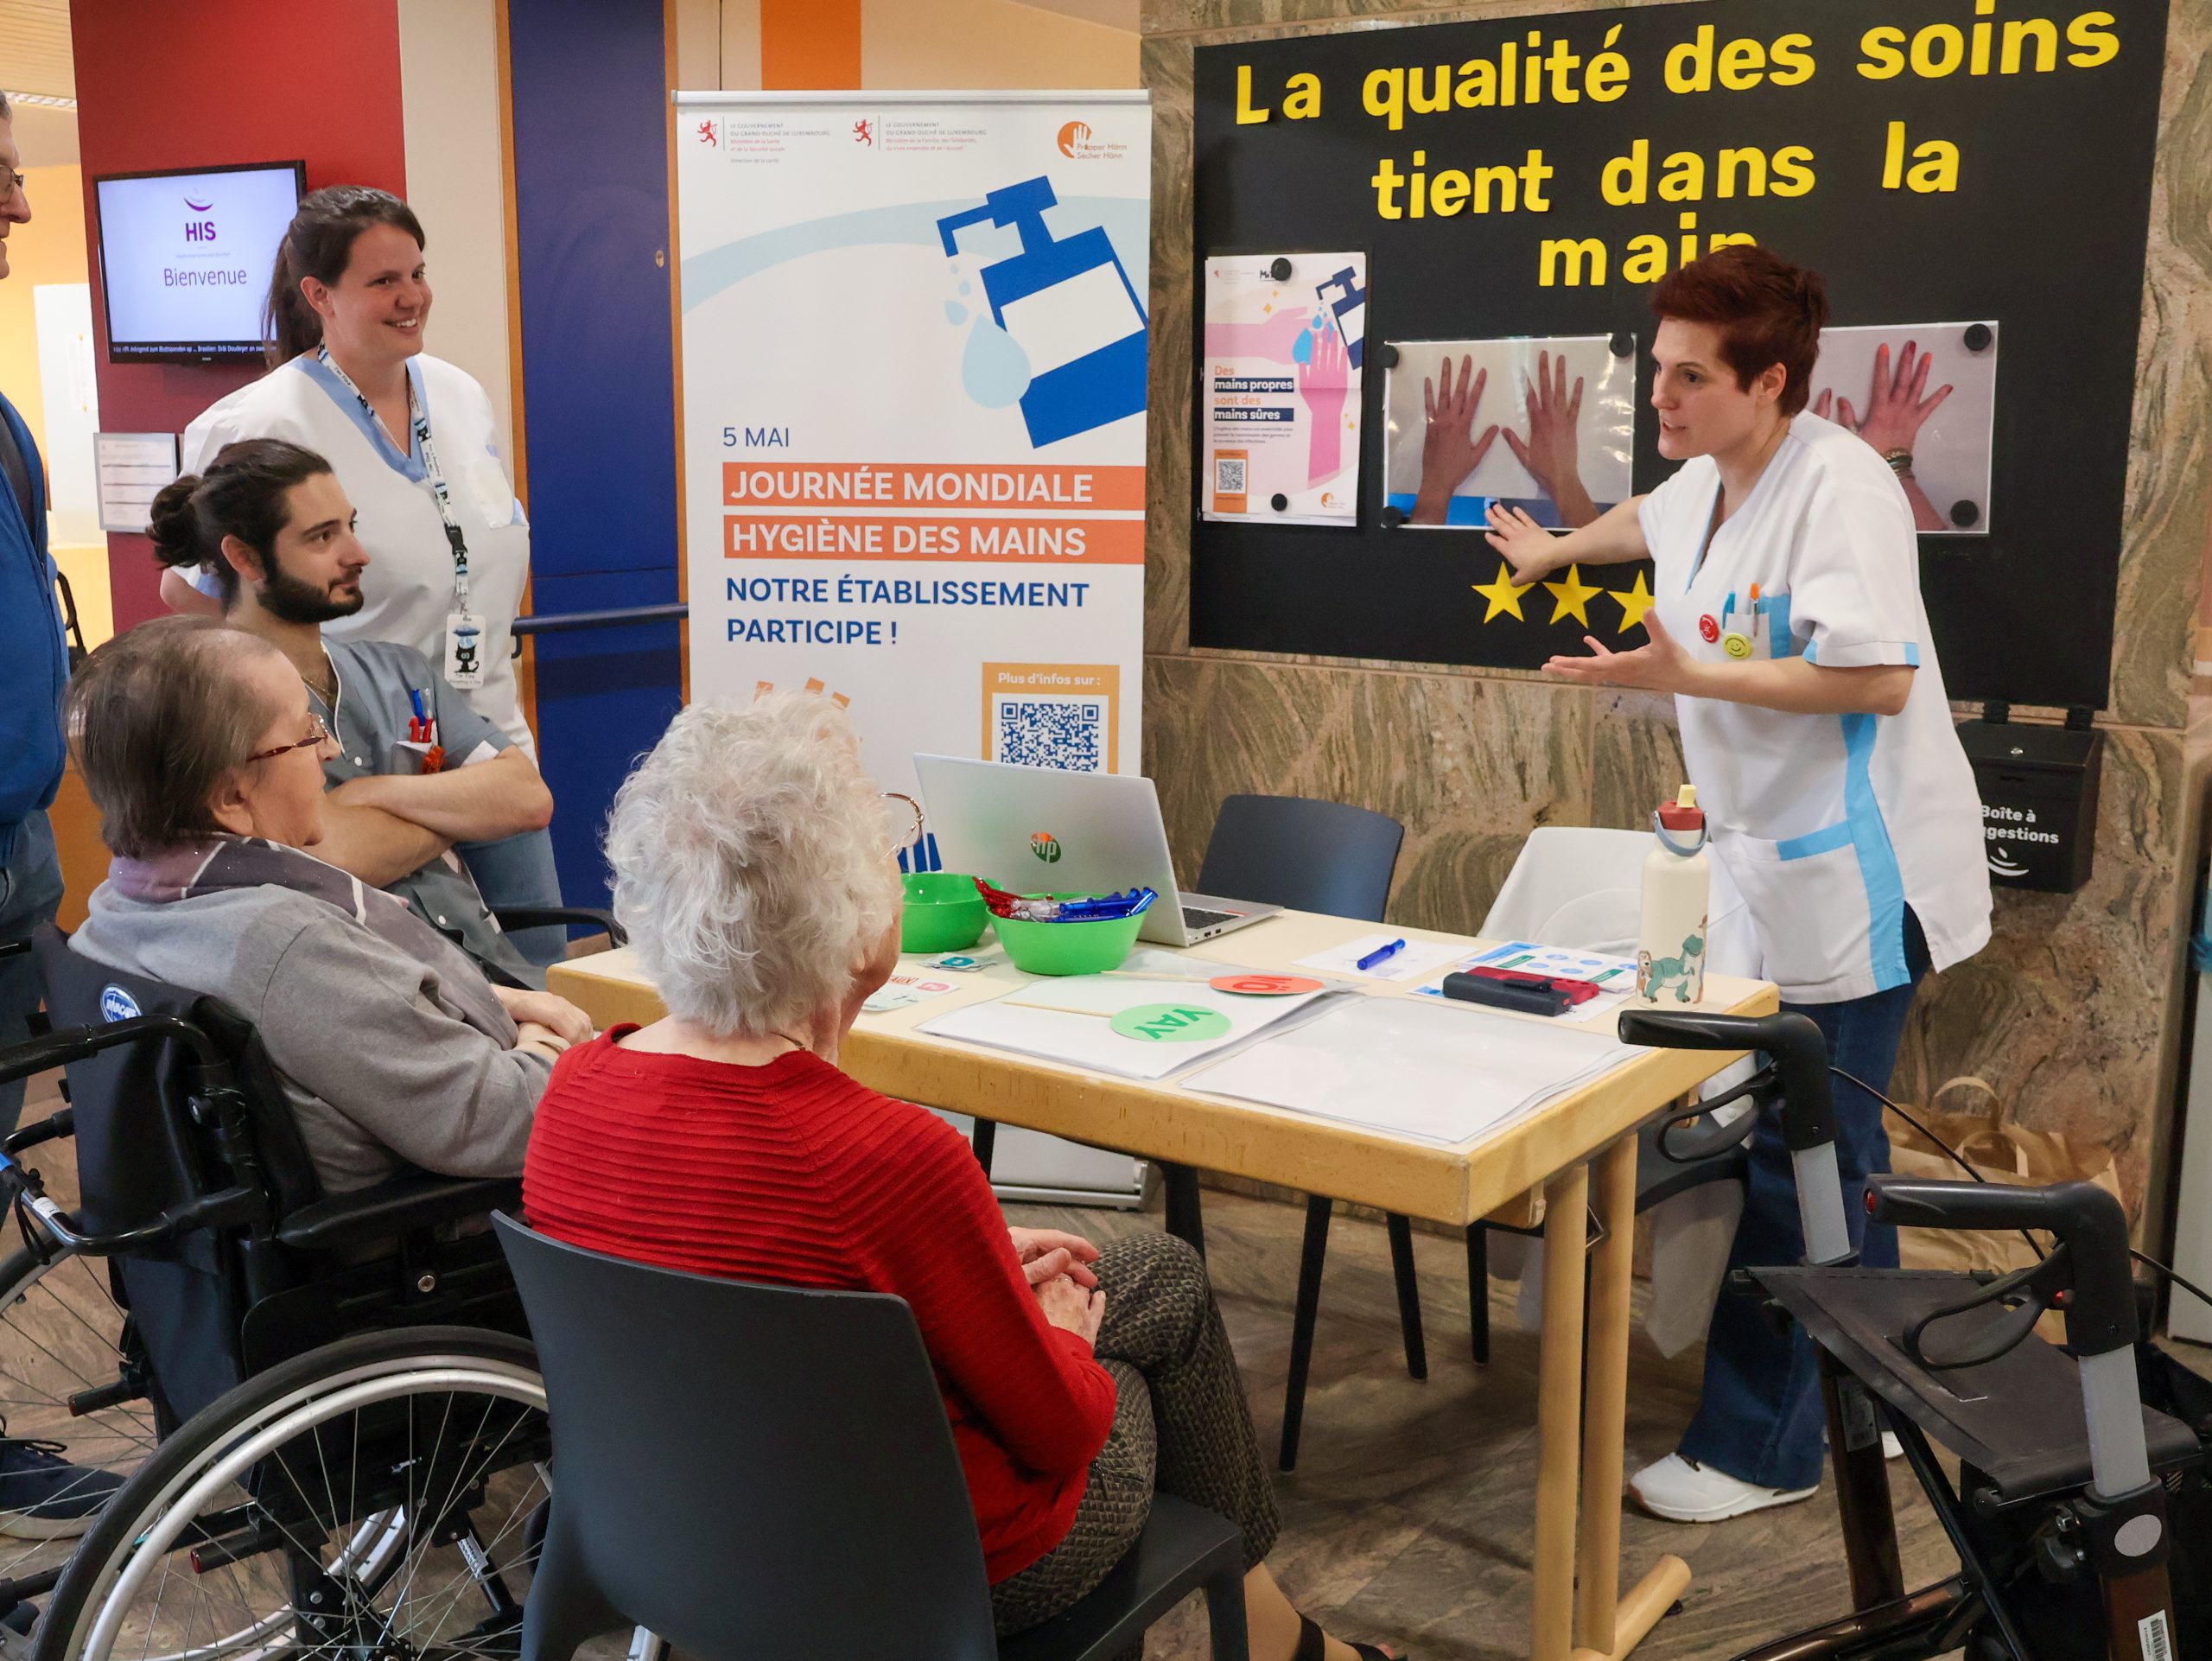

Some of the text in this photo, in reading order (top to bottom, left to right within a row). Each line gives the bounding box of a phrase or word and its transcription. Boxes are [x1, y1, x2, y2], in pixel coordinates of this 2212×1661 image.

[1236, 0, 2120, 131] La qualité des soins
[1370, 121, 1960, 220] tient dans la
[185, 221, 217, 242] HIS
[163, 268, 247, 287] Bienvenue
[1215, 366, 1235, 375] Des
[1214, 379, 1294, 392] mains propres
[1214, 396, 1261, 405] sont des
[1214, 409, 1281, 420] mains sûres
[723, 427, 790, 448] 5 MAI
[730, 466, 1094, 503] JOURNÉE MONDIALE
[732, 518, 1086, 556] HYGIÈNE DES MAINS
[727, 574, 1090, 608] NOTRE ÉTABLISSEMENT
[727, 619, 882, 645] PARTICIPE
[998, 672, 1025, 684] Plus
[1027, 673, 1071, 685] d'infos
[1074, 677, 1095, 685] sur
[1981, 805, 2037, 823] Boîte à
[1985, 826, 2060, 844] gestions
[1133, 1009, 1214, 1041] YAY
